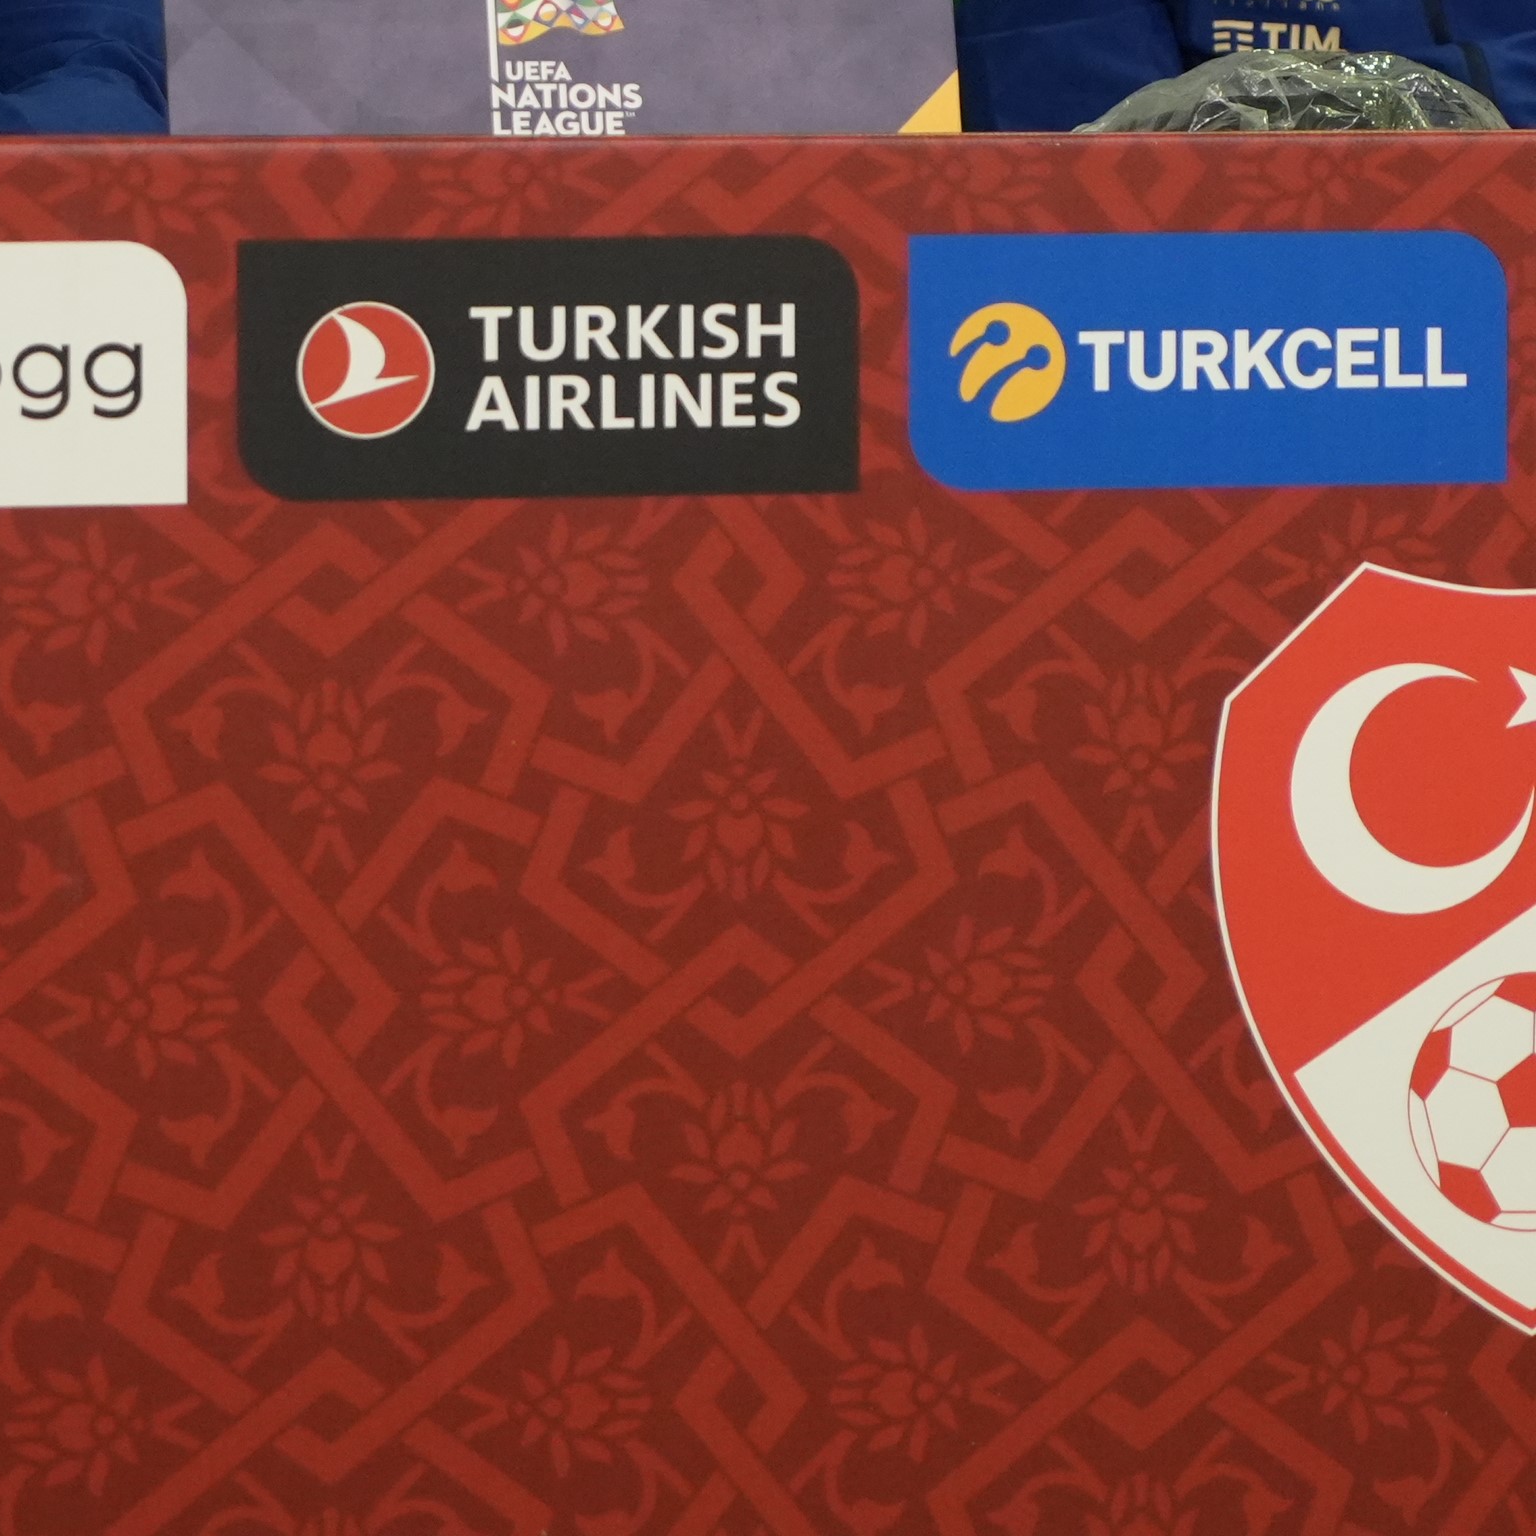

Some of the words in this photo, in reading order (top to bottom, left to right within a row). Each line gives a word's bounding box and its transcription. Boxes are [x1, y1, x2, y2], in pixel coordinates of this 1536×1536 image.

[1261, 22, 1342, 52] TIM
[505, 61, 572, 81] UEFA
[491, 83, 643, 109] NATIONS
[469, 302, 796, 362] TURKISH
[1077, 326, 1468, 392] TURKCELL
[465, 371, 801, 432] AIRLINES
